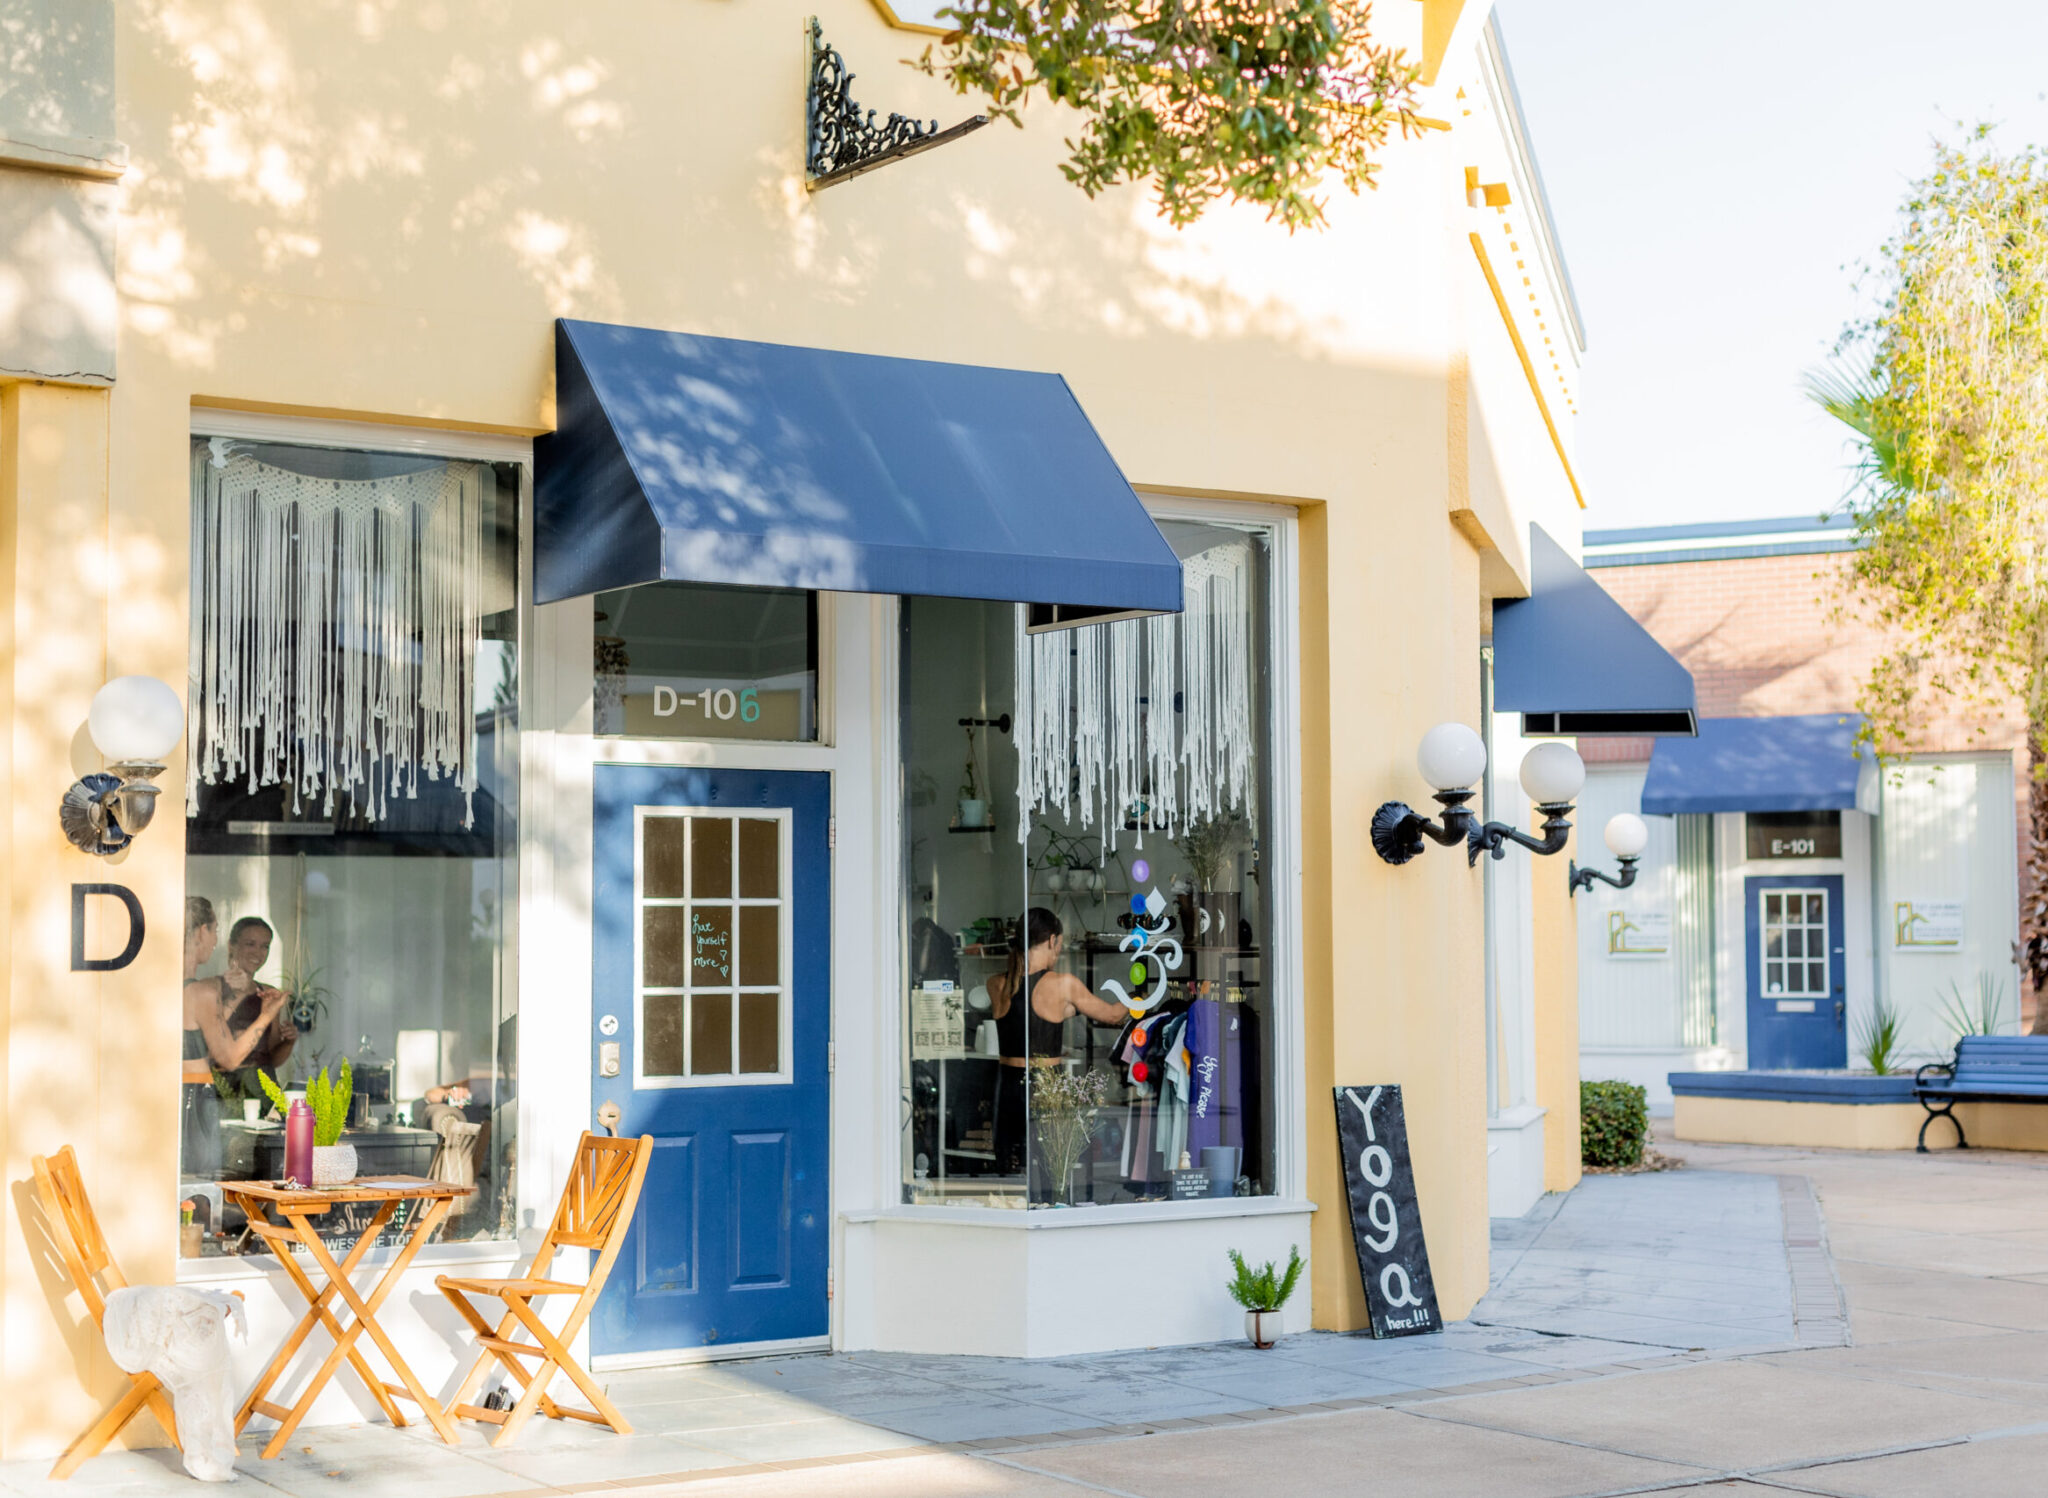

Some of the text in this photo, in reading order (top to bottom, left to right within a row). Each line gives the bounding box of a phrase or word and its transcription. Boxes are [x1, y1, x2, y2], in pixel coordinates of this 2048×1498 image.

[653, 685, 761, 723] D-106
[1771, 838, 1815, 855] E-101
[70, 883, 145, 971] D
[1196, 1055, 1219, 1083] Yoga
[1345, 1085, 1423, 1308] Yoga
